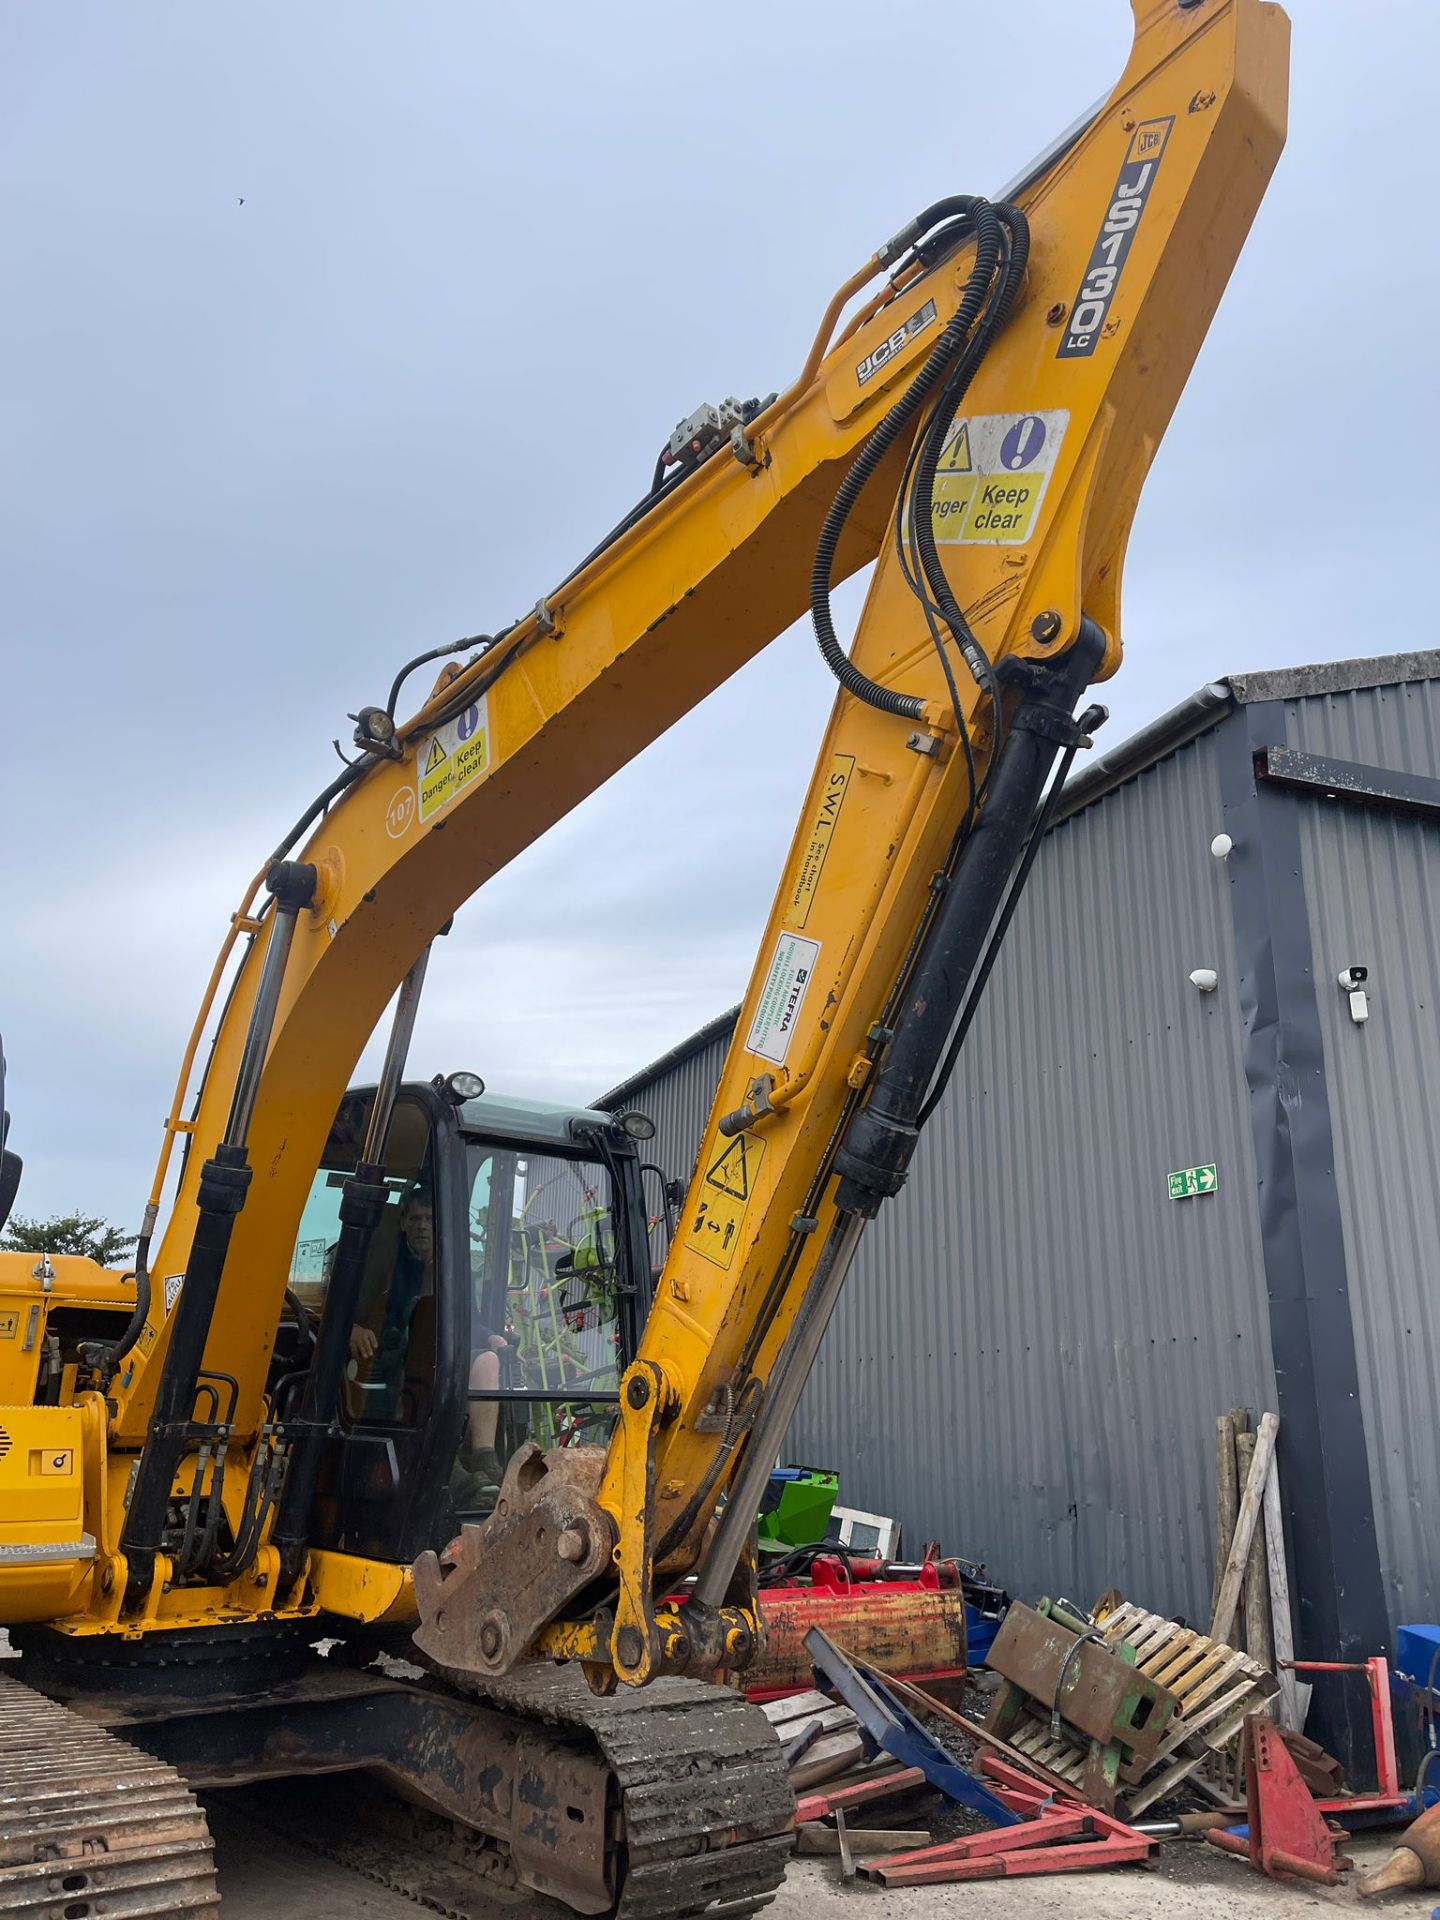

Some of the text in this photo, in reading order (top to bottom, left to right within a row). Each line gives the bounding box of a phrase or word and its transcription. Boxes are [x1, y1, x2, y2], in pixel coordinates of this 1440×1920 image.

[1140, 133, 1159, 151] JCB
[1070, 163, 1152, 334] JS130
[857, 326, 907, 379] JCB
[1067, 335, 1090, 348] LC
[931, 499, 967, 517] nger
[982, 484, 1030, 508] Keep
[974, 510, 1022, 530] clear
[457, 739, 482, 767] Keep
[458, 755, 482, 781] clear
[422, 771, 452, 803] Danger
[390, 796, 412, 825] 107
[815, 774, 845, 836] S.W.L.
[793, 854, 813, 907] handbook
[805, 842, 825, 892] See chart
[770, 962, 781, 986] SAFETY
[758, 941, 796, 1049] DOUBLE LOCKING COUPLER FITTED
[773, 968, 795, 1026] FULLY AUTOMATIC
[780, 986, 801, 1032] TEFRA
[755, 1000, 769, 1034] REQUIRED
